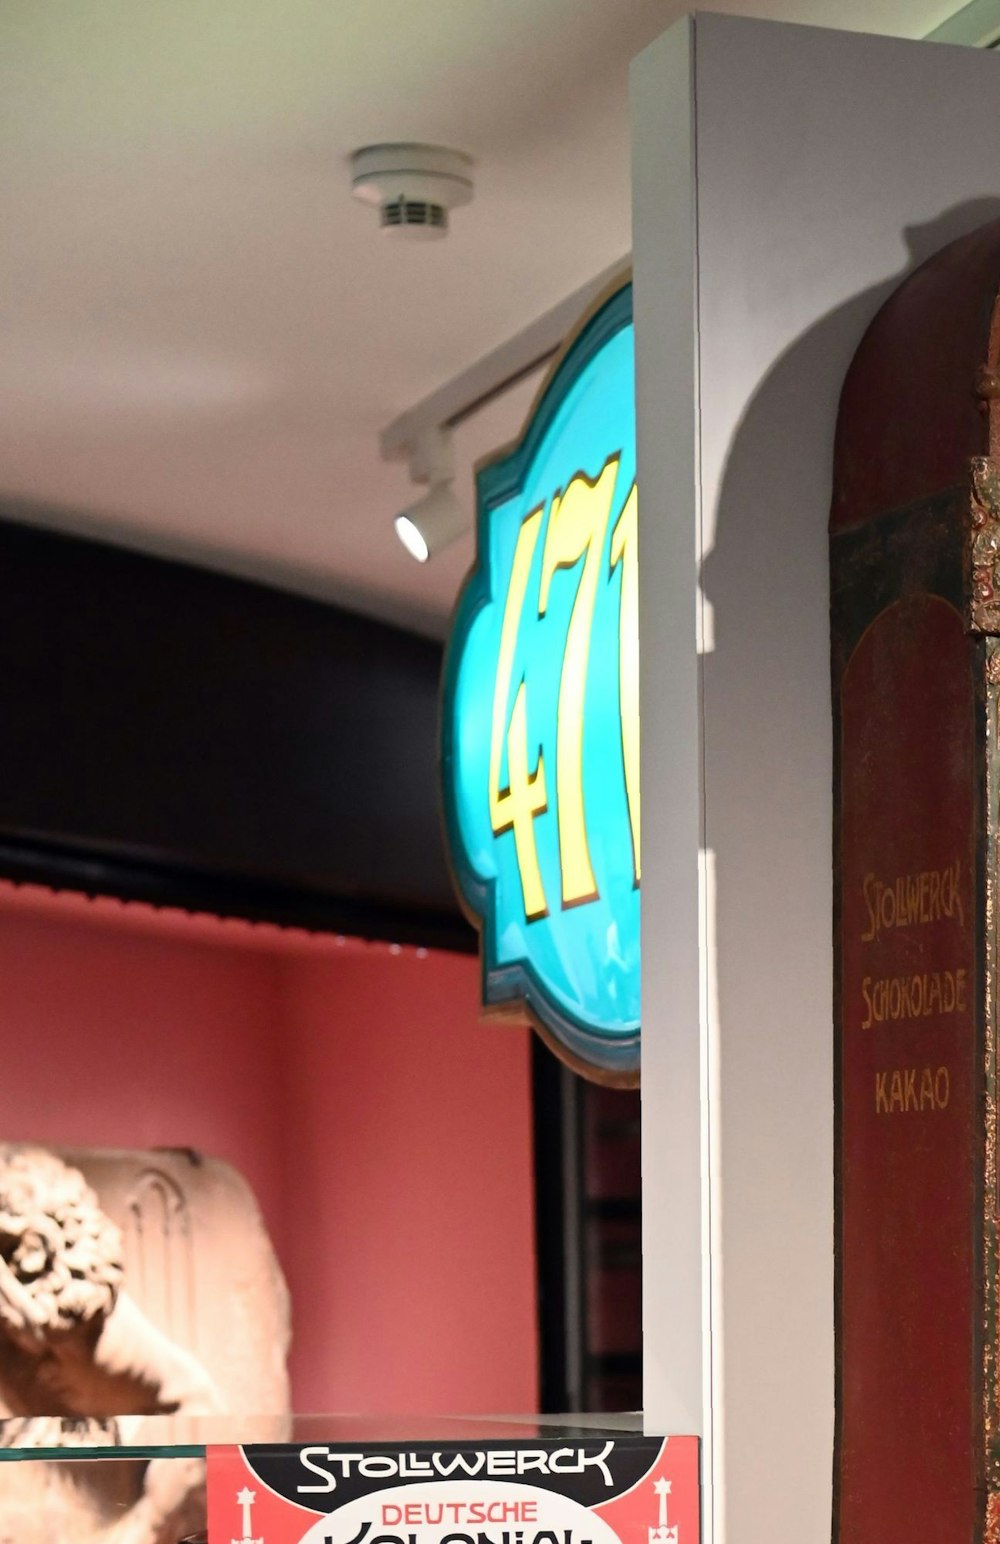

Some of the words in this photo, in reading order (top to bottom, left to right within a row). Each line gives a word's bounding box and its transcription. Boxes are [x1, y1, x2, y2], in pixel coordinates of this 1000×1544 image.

[861, 861, 965, 942] STOLLWERCK
[861, 969, 967, 1030] SCHOKOLADE
[875, 1066, 950, 1114] KAKAO
[297, 1441, 615, 1493] STOLLWERCK
[382, 1501, 538, 1526] DEUTSCHE
